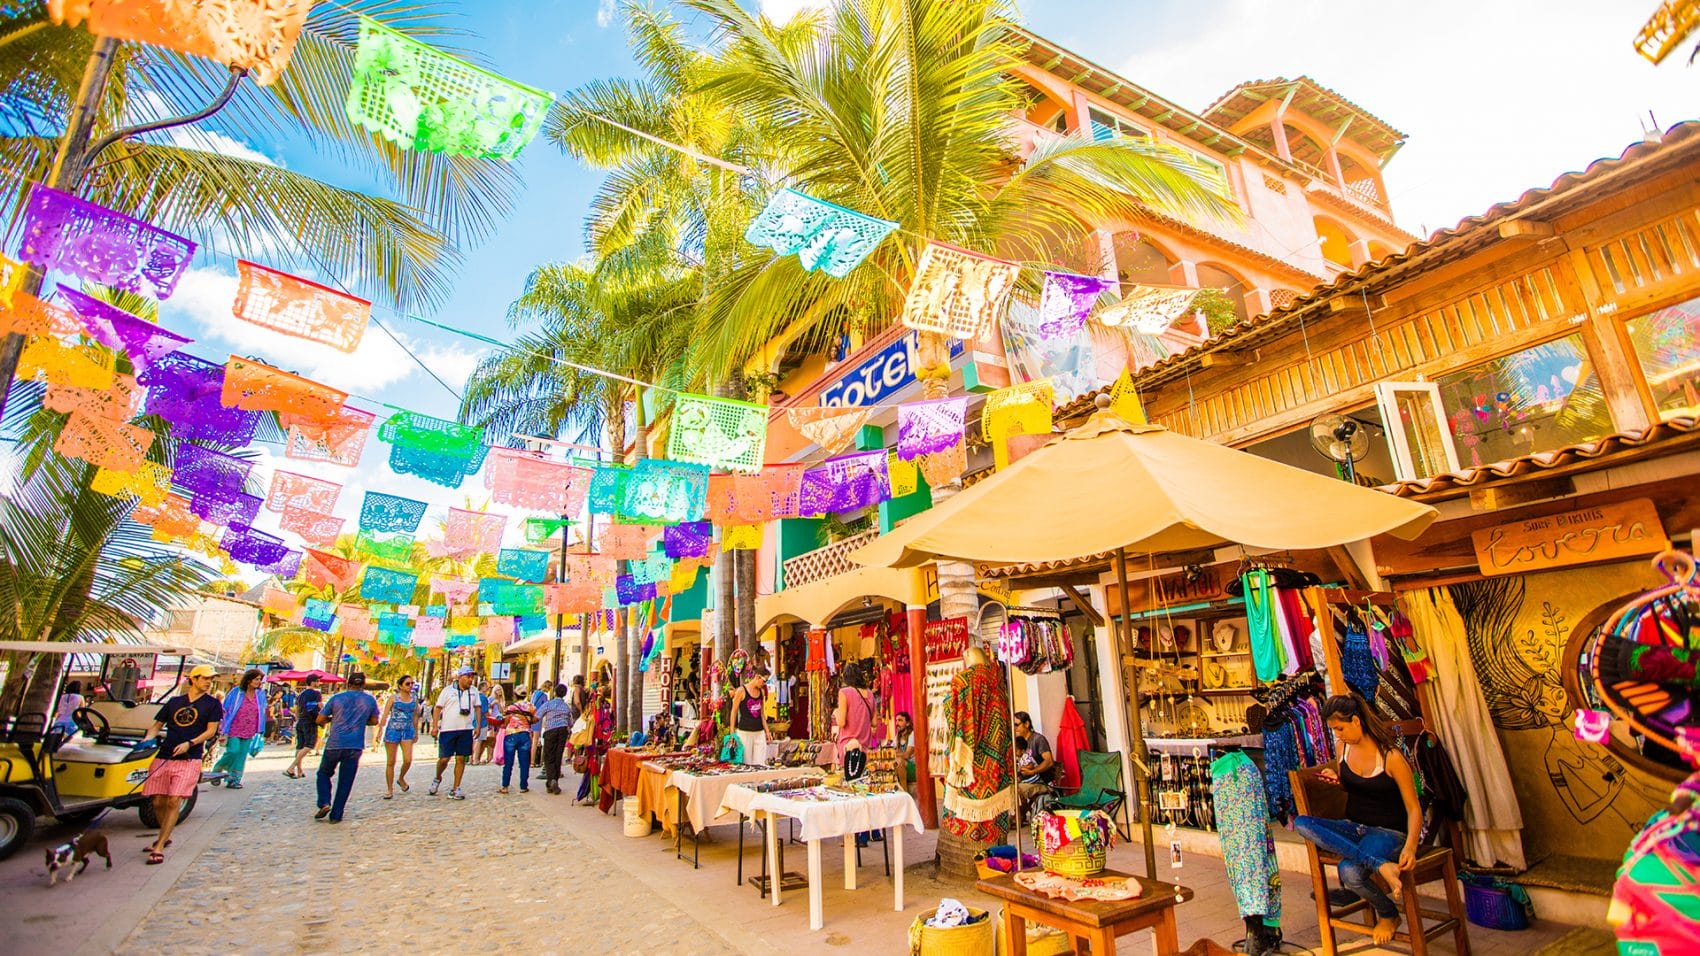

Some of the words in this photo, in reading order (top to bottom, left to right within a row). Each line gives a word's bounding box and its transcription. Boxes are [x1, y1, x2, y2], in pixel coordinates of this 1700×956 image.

[1522, 519, 1551, 532] SURF
[1556, 510, 1604, 527] BIKINIS
[661, 659, 671, 712] HOTE
